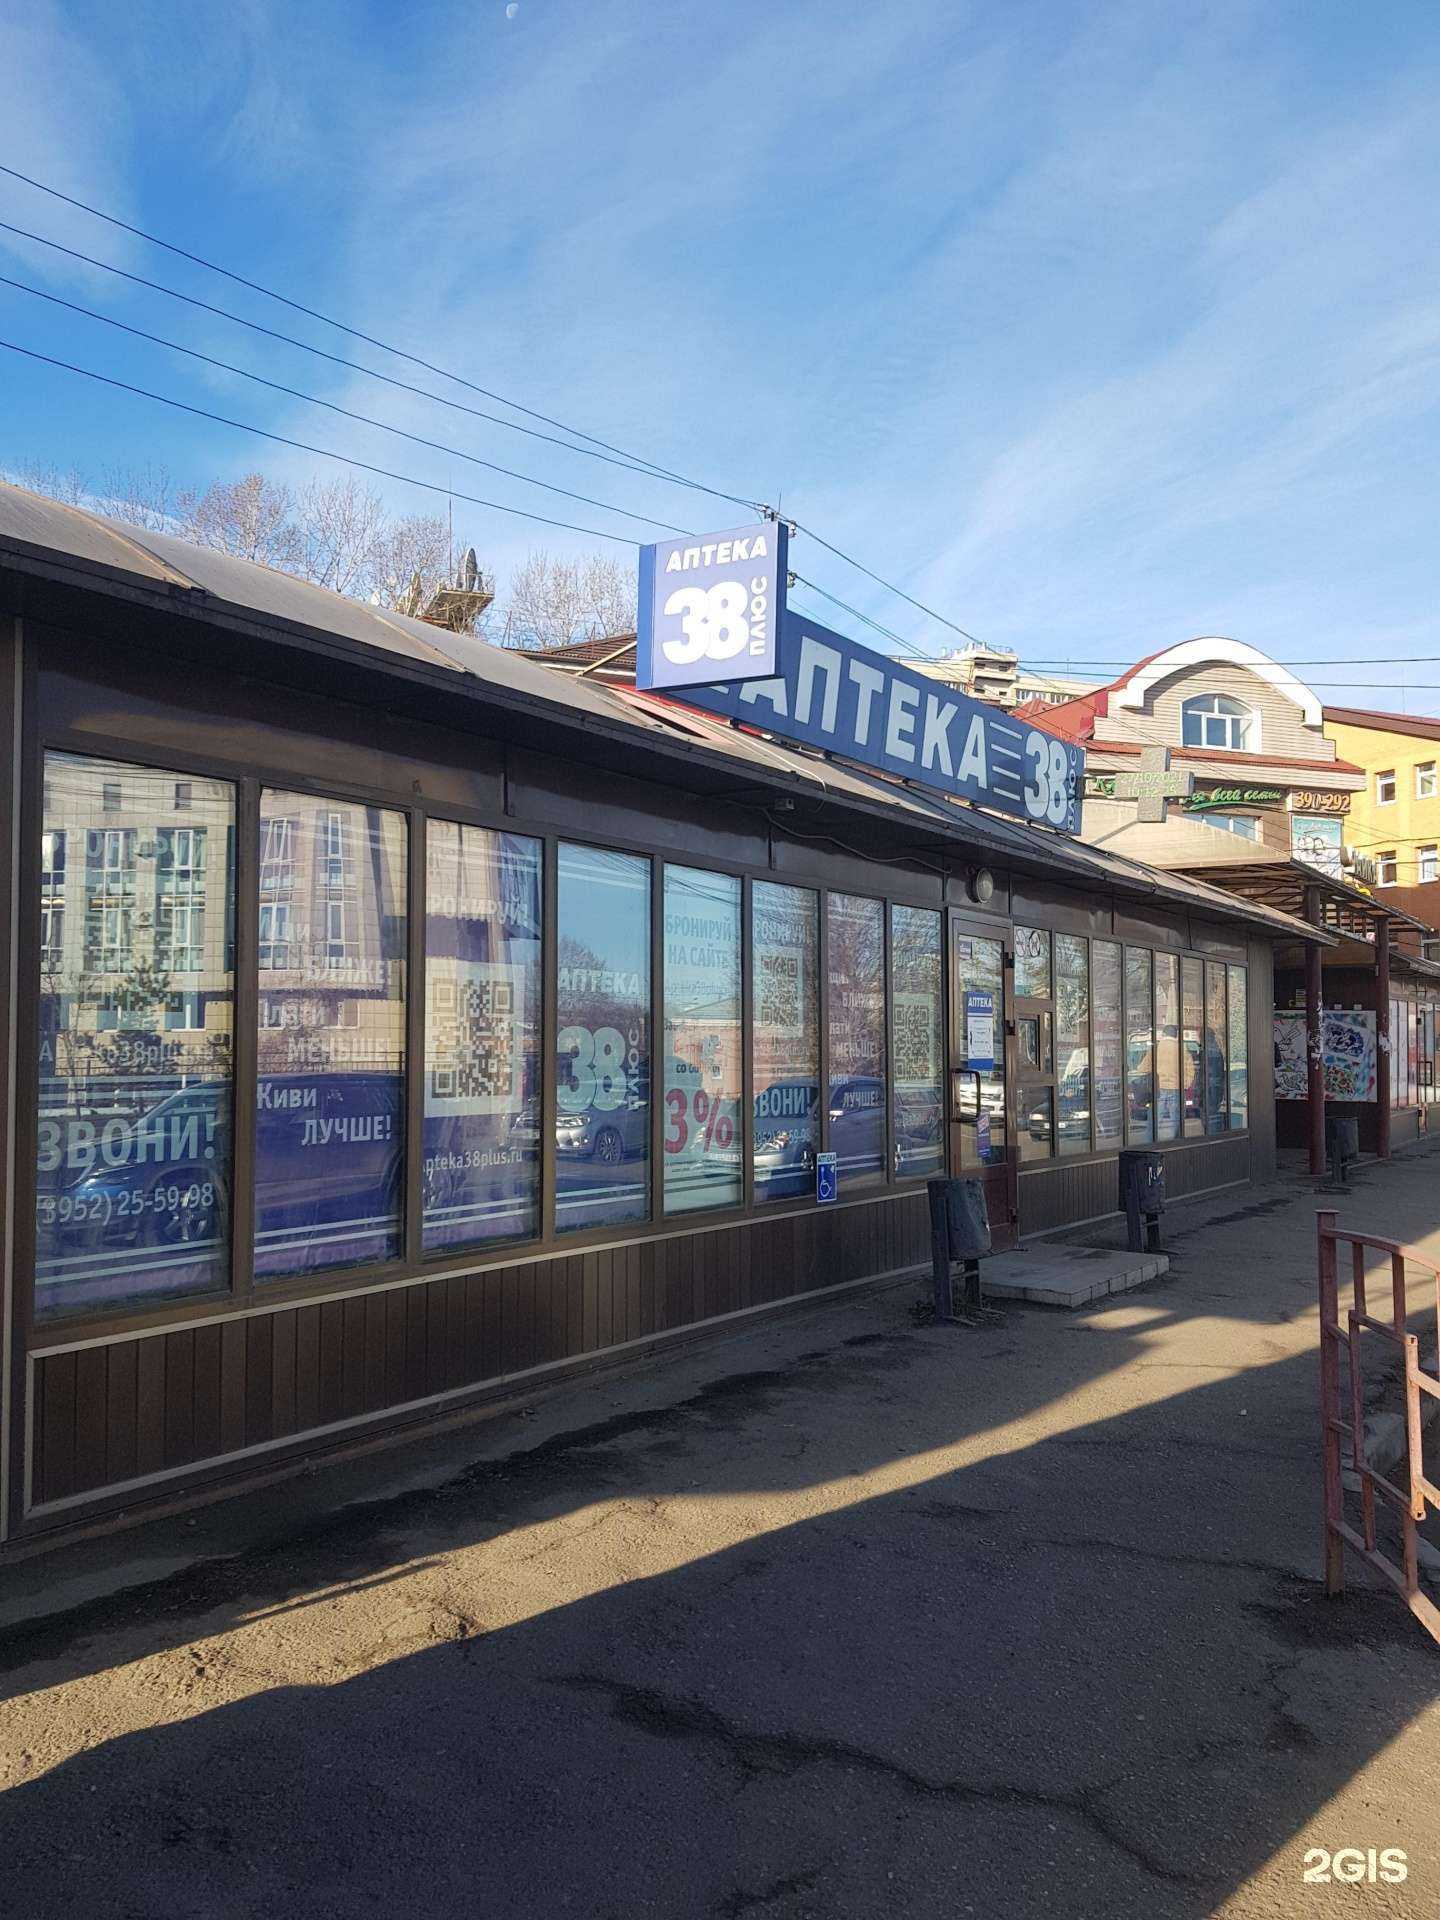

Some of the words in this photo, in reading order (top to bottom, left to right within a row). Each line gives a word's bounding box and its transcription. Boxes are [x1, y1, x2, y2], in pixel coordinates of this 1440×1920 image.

[665, 535, 768, 573] АПТЕКА
[662, 581, 749, 665] 38
[749, 575, 768, 656] ПЛЮС
[1024, 731, 1068, 825] 38
[668, 944, 688, 965] НА
[559, 968, 640, 995] АПТЕКА
[968, 997, 992, 1008] АПТЕКА
[557, 1026, 626, 1111] 38
[628, 1028, 640, 1110] ПЛЮС
[37, 1114, 216, 1171] ЗВОНИ!
[301, 1115, 393, 1146] ЛУЧШЕ!
[664, 1088, 734, 1154] 3%
[424, 1149, 523, 1176] pteka38plus.ru
[117, 1183, 214, 1216] 25-59-98
